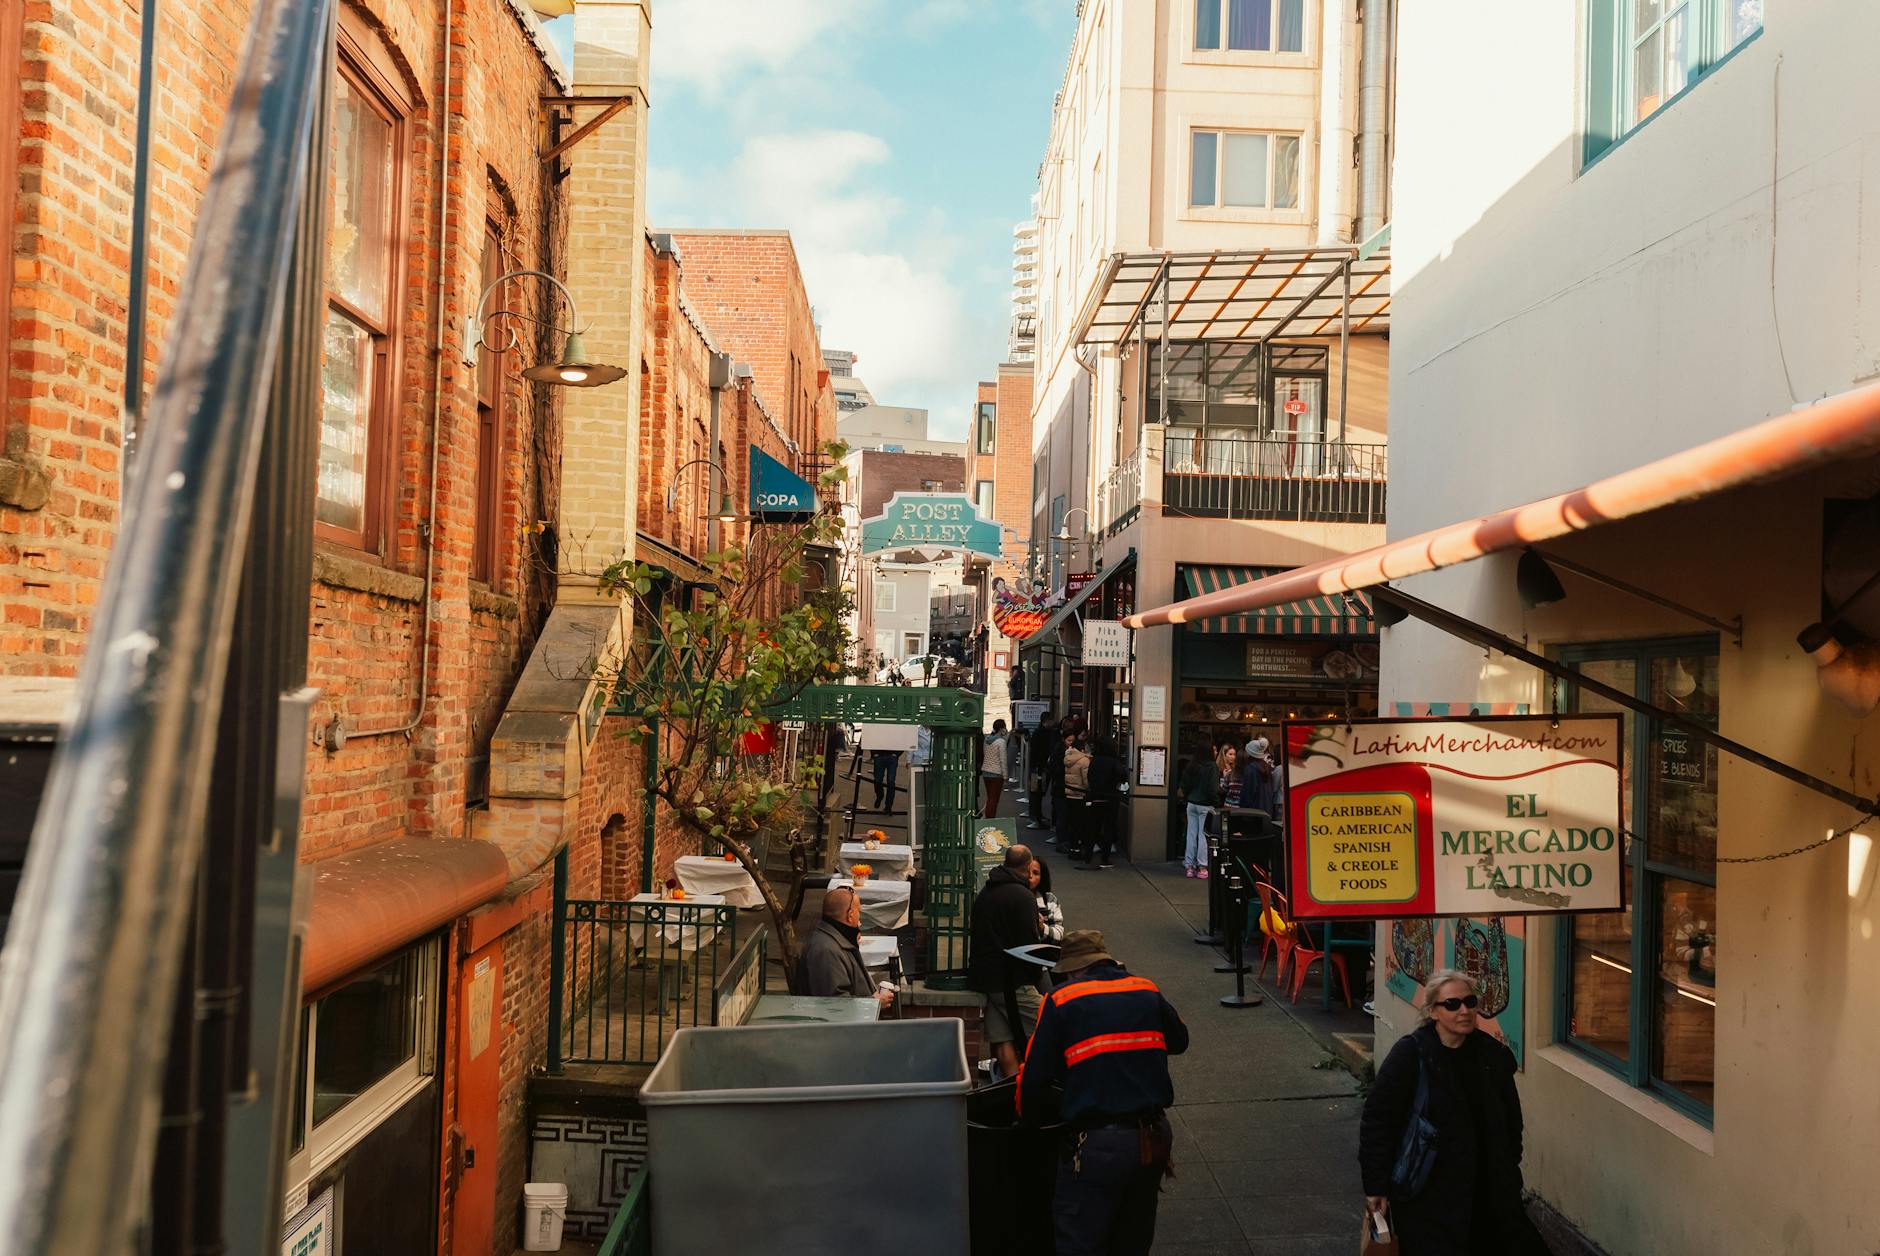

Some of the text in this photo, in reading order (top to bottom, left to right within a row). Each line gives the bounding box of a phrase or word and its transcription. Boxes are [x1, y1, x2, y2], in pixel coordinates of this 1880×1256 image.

[756, 494, 798, 506] COPA
[902, 503, 962, 520] POST
[892, 524, 973, 542] ALLEY
[1007, 616, 1043, 626] EUROPEAN
[1098, 626, 1117, 636] Pike
[1095, 637, 1119, 647] Place
[1088, 648, 1125, 658] Chowder
[1252, 655, 1263, 663] DAY
[1272, 656, 1285, 664] THE
[1353, 731, 1607, 756] LatinMerchant.com
[1663, 739, 1688, 754] SPICES
[1671, 761, 1700, 777] BLENDS
[1320, 805, 1402, 817] CARIBBEAN
[1506, 793, 1548, 818] EL
[1311, 823, 1412, 836] SO. AMERICAN
[1441, 827, 1614, 856] MERCADO
[1333, 842, 1391, 854] SPANISH
[1327, 860, 1399, 872] & CREOLE
[1466, 862, 1592, 890] LATINO
[1340, 878, 1388, 890] FOODS
